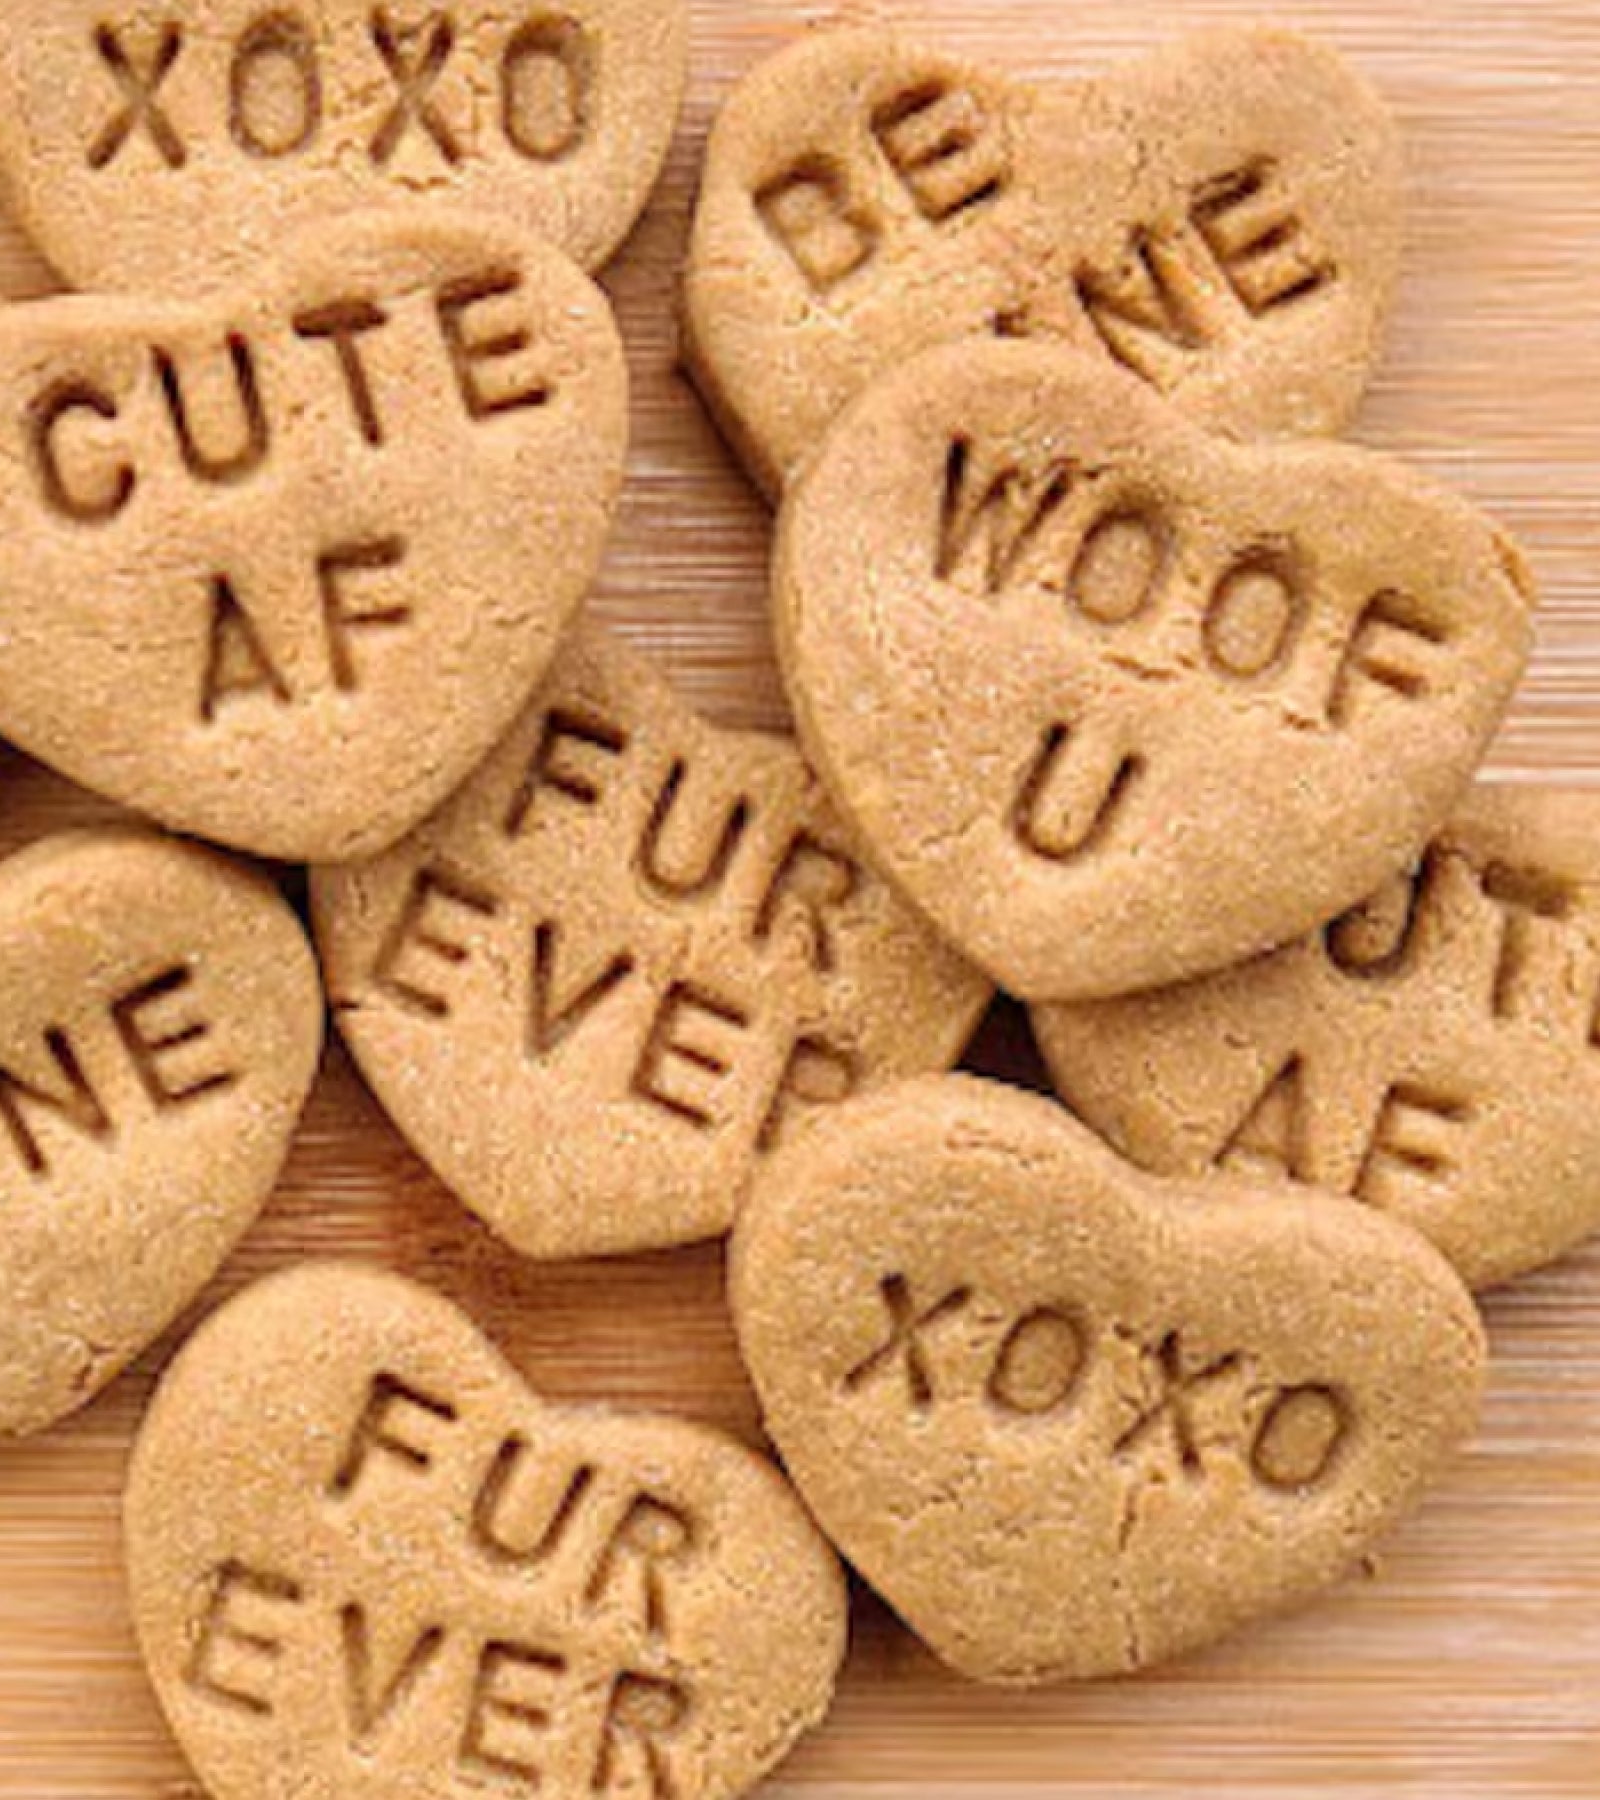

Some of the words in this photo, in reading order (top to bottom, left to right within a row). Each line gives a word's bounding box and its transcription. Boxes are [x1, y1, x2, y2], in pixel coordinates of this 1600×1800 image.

[86, 6, 598, 172] XOXO
[752, 80, 1013, 294] BE
[990, 152, 1340, 396] NE
[19, 267, 560, 525] CUTE
[195, 538, 413, 724] AF
[930, 430, 1455, 728] WOOF
[502, 703, 866, 972] FUR
[1009, 722, 1145, 862] U
[1322, 834, 1600, 1052] UT
[1211, 1046, 1478, 1202] AF
[840, 1270, 1362, 1495] XOXO
[330, 1370, 697, 1635] FUR
[185, 1555, 692, 1800] EVER
